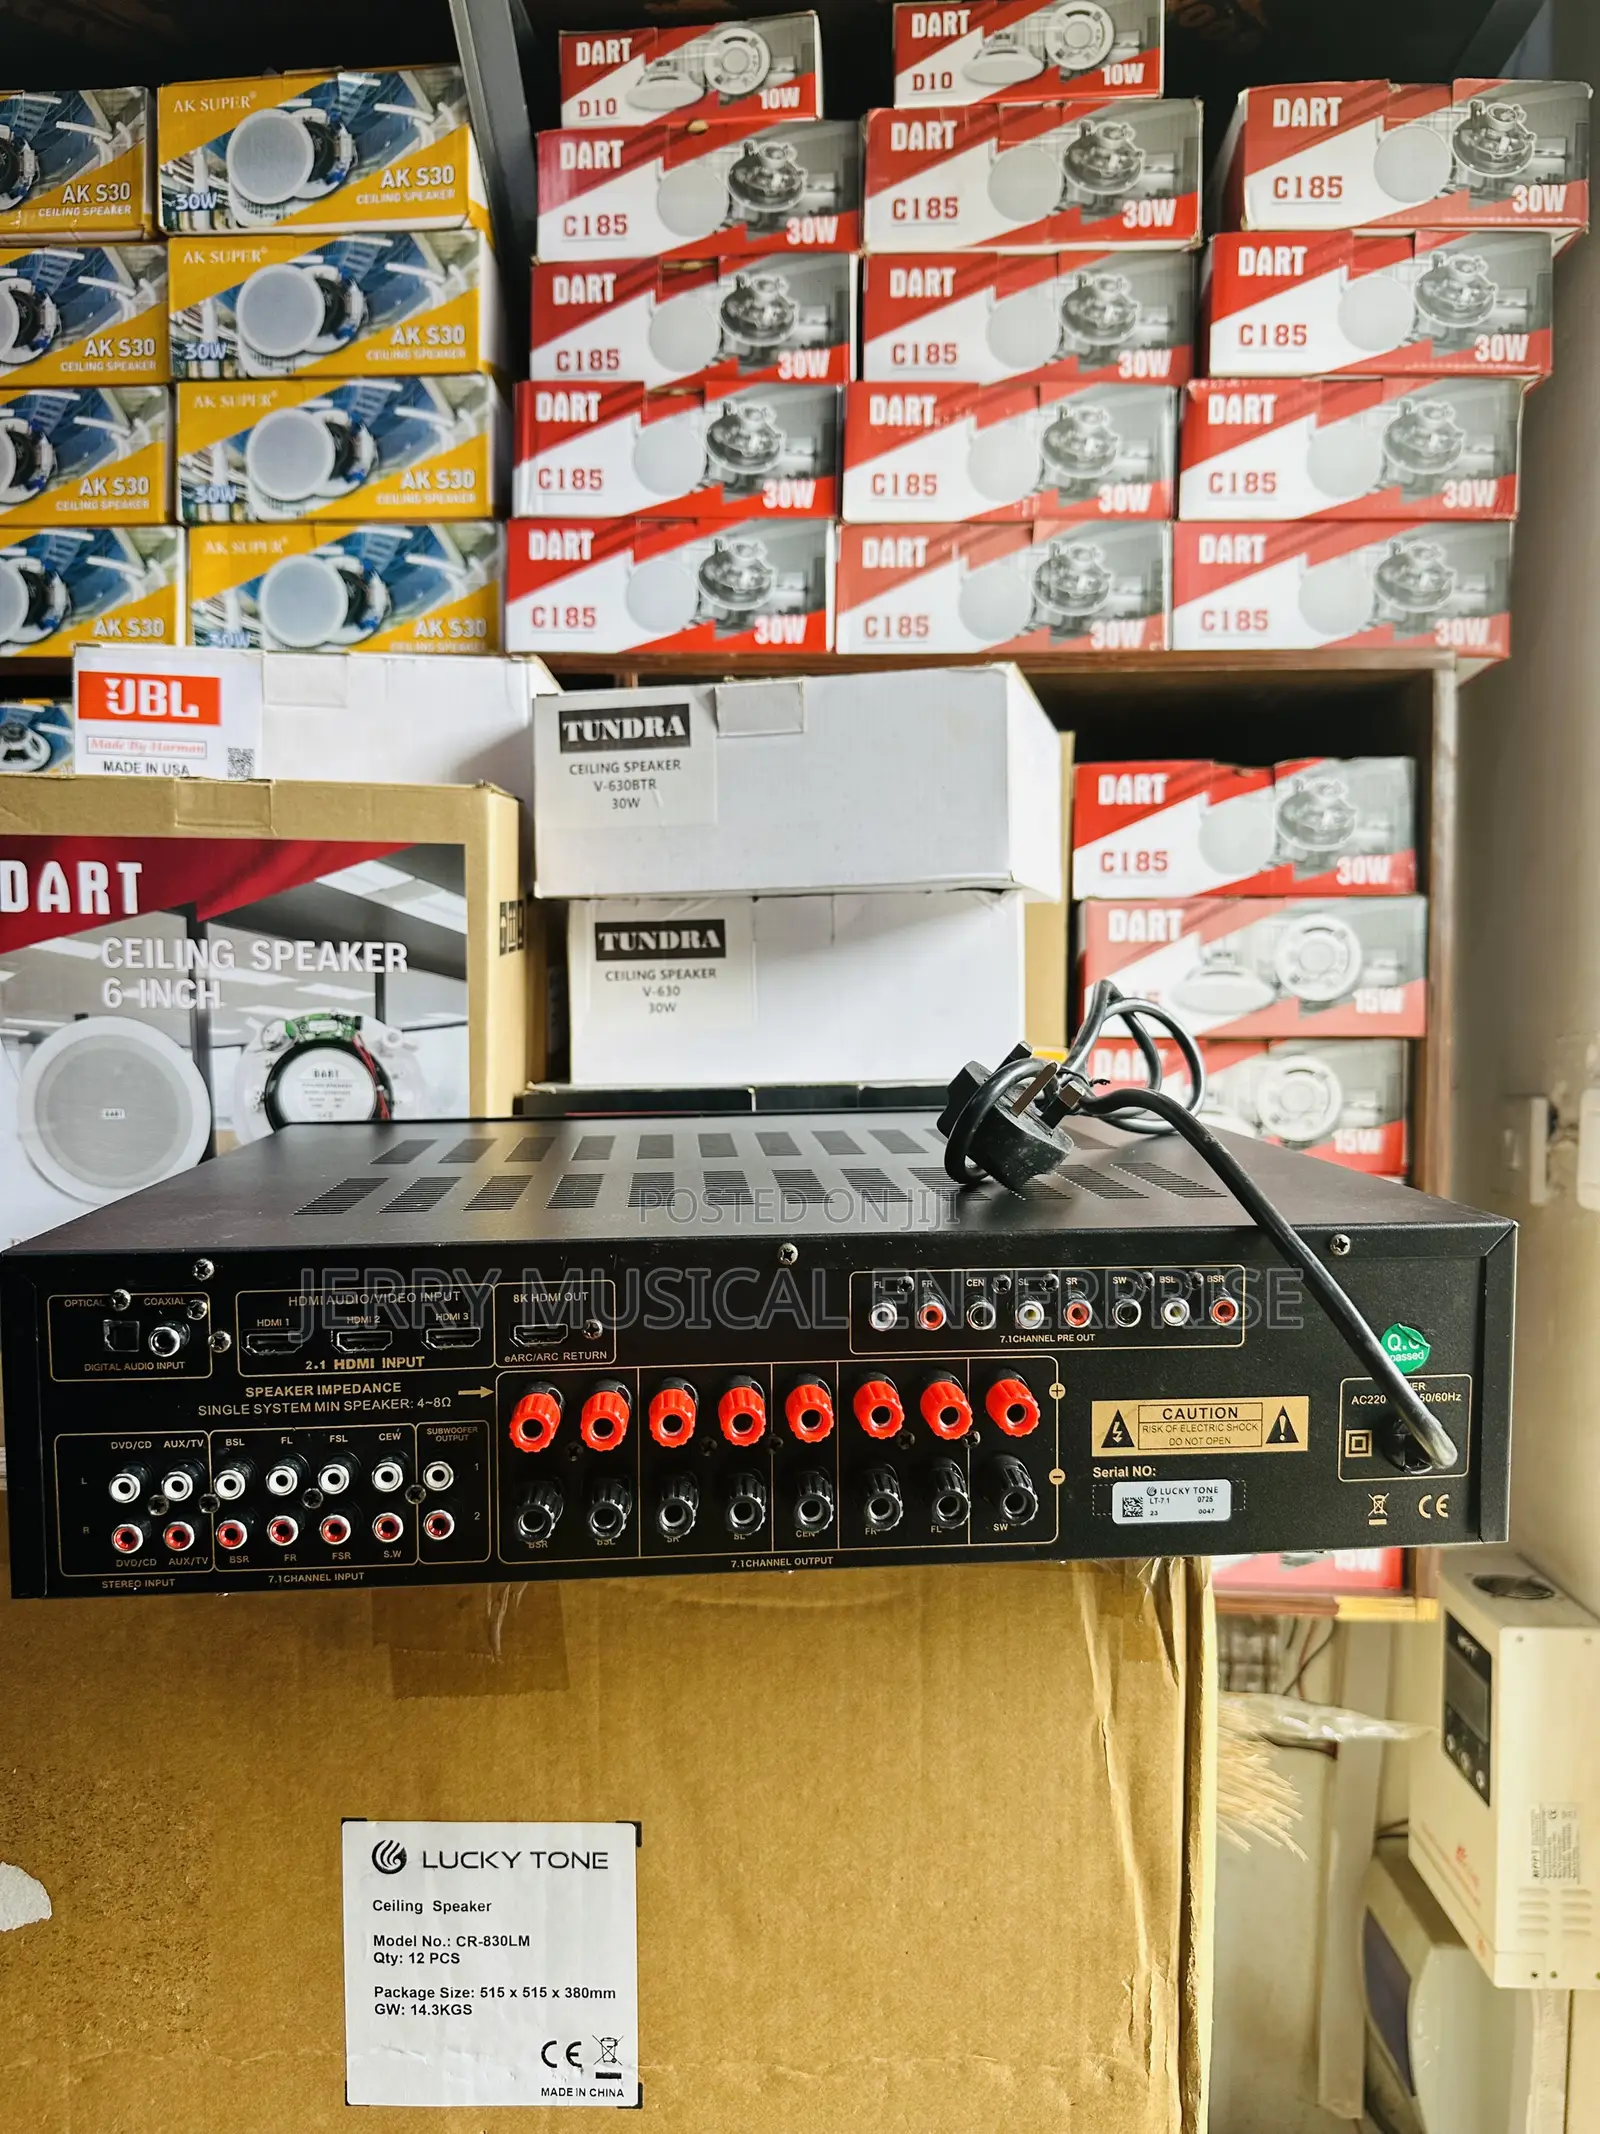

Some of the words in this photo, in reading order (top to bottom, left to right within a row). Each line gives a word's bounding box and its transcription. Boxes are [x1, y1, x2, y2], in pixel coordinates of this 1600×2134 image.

[911, 10, 971, 38] DART
[576, 37, 632, 66] DART
[1102, 63, 1145, 86] 10W
[912, 72, 953, 91] D10
[760, 87, 800, 110] 10W
[174, 99, 197, 113] AK
[579, 99, 617, 117] D10
[1273, 97, 1342, 128] DART
[890, 121, 957, 151] DART
[560, 140, 624, 170] DART
[380, 168, 411, 189] AK
[416, 164, 455, 187] S30
[62, 183, 92, 205] AK
[96, 181, 131, 203] S30
[1273, 176, 1344, 200] C185
[1512, 184, 1567, 213] 30W
[892, 197, 959, 221] C185
[1122, 199, 1176, 229] 30W
[564, 214, 628, 238] C185
[786, 216, 839, 245] 30W
[1198, 534, 1268, 565] DART
[104, 677, 200, 718] JBL
[563, 715, 686, 742] TUNDRA
[103, 761, 141, 773] MADE
[146, 763, 158, 774] IN
[163, 763, 190, 775] USA
[569, 762, 619, 775] CEILING
[624, 760, 681, 773] SPEAKER
[594, 779, 657, 792] V-630BTR
[1098, 774, 1169, 805] DART
[612, 798, 640, 809] 30W
[1100, 850, 1169, 873] C185
[1336, 856, 1392, 885] 30W
[0, 859, 143, 915] DART
[1107, 909, 1184, 942] DART
[598, 929, 721, 951] TUNDRA
[101, 936, 235, 970] CEILING
[251, 940, 409, 973] SPEAKER
[605, 970, 656, 982] CEILING
[660, 968, 716, 979] SPEAKER
[139, 978, 222, 1010] INCH
[643, 986, 680, 997] V-630
[649, 1003, 677, 1014] 30W
[966, 1279, 985, 1287] CEN
[1159, 1276, 1176, 1284] BSL
[1207, 1275, 1225, 1283] BSR
[64, 1298, 105, 1308] OPTICAL
[144, 1297, 186, 1306] COAXIAL
[288, 1295, 323, 1307] HDMI
[326, 1292, 416, 1305] AUDIO/VIDEO
[420, 1290, 461, 1302] INPUT
[513, 1293, 528, 1304] 8K
[531, 1292, 561, 1302] HDMI
[564, 1291, 588, 1301] OUT
[257, 1319, 283, 1327] HDMI
[285, 1318, 289, 1326] 1
[346, 1316, 372, 1324] HDMI
[374, 1315, 380, 1324] 2
[435, 1312, 461, 1321] HDMI
[463, 1312, 469, 1320] 3
[1000, 1335, 1055, 1343] 7.1CHANNEL
[1057, 1334, 1074, 1342] PRE
[1076, 1334, 1095, 1342] OUT
[305, 1360, 325, 1370] 2.1
[334, 1358, 375, 1370] HDMI
[382, 1356, 425, 1368] INPUT
[504, 1352, 559, 1363] eARC/ARC
[563, 1350, 608, 1361] RETURN
[84, 1363, 121, 1372] DIGITAL
[124, 1362, 154, 1371] AUDIO
[156, 1361, 186, 1370] INPUT
[245, 1385, 313, 1398] SPEAKER
[316, 1382, 402, 1395] IMPEDANCE
[198, 1403, 250, 1416] SINGLE
[253, 1402, 312, 1415] SYSTEM
[315, 1401, 340, 1413] MIN
[343, 1399, 414, 1412] SPEAKER:
[1162, 1407, 1239, 1420] CAUTION
[426, 1427, 478, 1435] SUBWOOFER
[1142, 1424, 1163, 1433] RISK
[1181, 1423, 1223, 1432] ELECTRIC
[1226, 1423, 1258, 1432] SHOCK
[225, 1438, 245, 1447] BSL
[281, 1436, 293, 1445] FL
[329, 1434, 348, 1443] FSL
[378, 1432, 402, 1441] CEW
[436, 1434, 469, 1442] OUTPUT
[1169, 1437, 1182, 1446] DO
[1185, 1437, 1203, 1446] NOT
[1206, 1436, 1231, 1445] OPEN
[111, 1440, 152, 1450] DVD/CD
[163, 1439, 204, 1449] AUX/TV
[1092, 1467, 1129, 1478] Serial
[1132, 1466, 1157, 1477] NO:
[1160, 1487, 1190, 1495] LUCKY
[1194, 1486, 1219, 1494] TONE
[931, 1525, 942, 1533] FL
[993, 1523, 1008, 1532] SW
[116, 1557, 157, 1568] DVD/CD
[169, 1556, 209, 1566] AUX/TV
[229, 1555, 250, 1564] BSR
[284, 1554, 297, 1562] FR
[332, 1552, 351, 1560] FSR
[731, 1557, 792, 1568] 7.1CHANNEL
[794, 1556, 834, 1566] OUTPUT
[102, 1579, 142, 1588] STEREO
[144, 1578, 176, 1587] INPUT
[268, 1573, 331, 1584] 7.1CHANNEL
[334, 1572, 365, 1581] INPUT
[422, 1850, 522, 1869] LUCKY
[530, 1850, 609, 1870] TONE
[372, 1899, 423, 1914] Ceiling
[432, 1900, 492, 1914] Speaker
[373, 1935, 417, 1947] Model
[422, 1935, 451, 1948] No.:
[456, 1935, 530, 1948] CR-830LM
[373, 1952, 403, 1966] Qty:
[408, 1952, 425, 1965] 12
[429, 1952, 460, 1965] PCS
[374, 1986, 435, 2001] Package
[439, 1986, 475, 1999] Size:
[480, 1987, 505, 1999] 515
[509, 1989, 518, 1999] x
[522, 1986, 548, 1999] 515
[551, 1990, 560, 1999] x
[564, 1987, 616, 1999] 380mm
[374, 2003, 405, 2016] GW:
[410, 2003, 473, 2016] 14.3KGS
[541, 2087, 573, 2097] MADE
[576, 2087, 586, 2097] IN
[589, 2088, 624, 2098] CHINA
